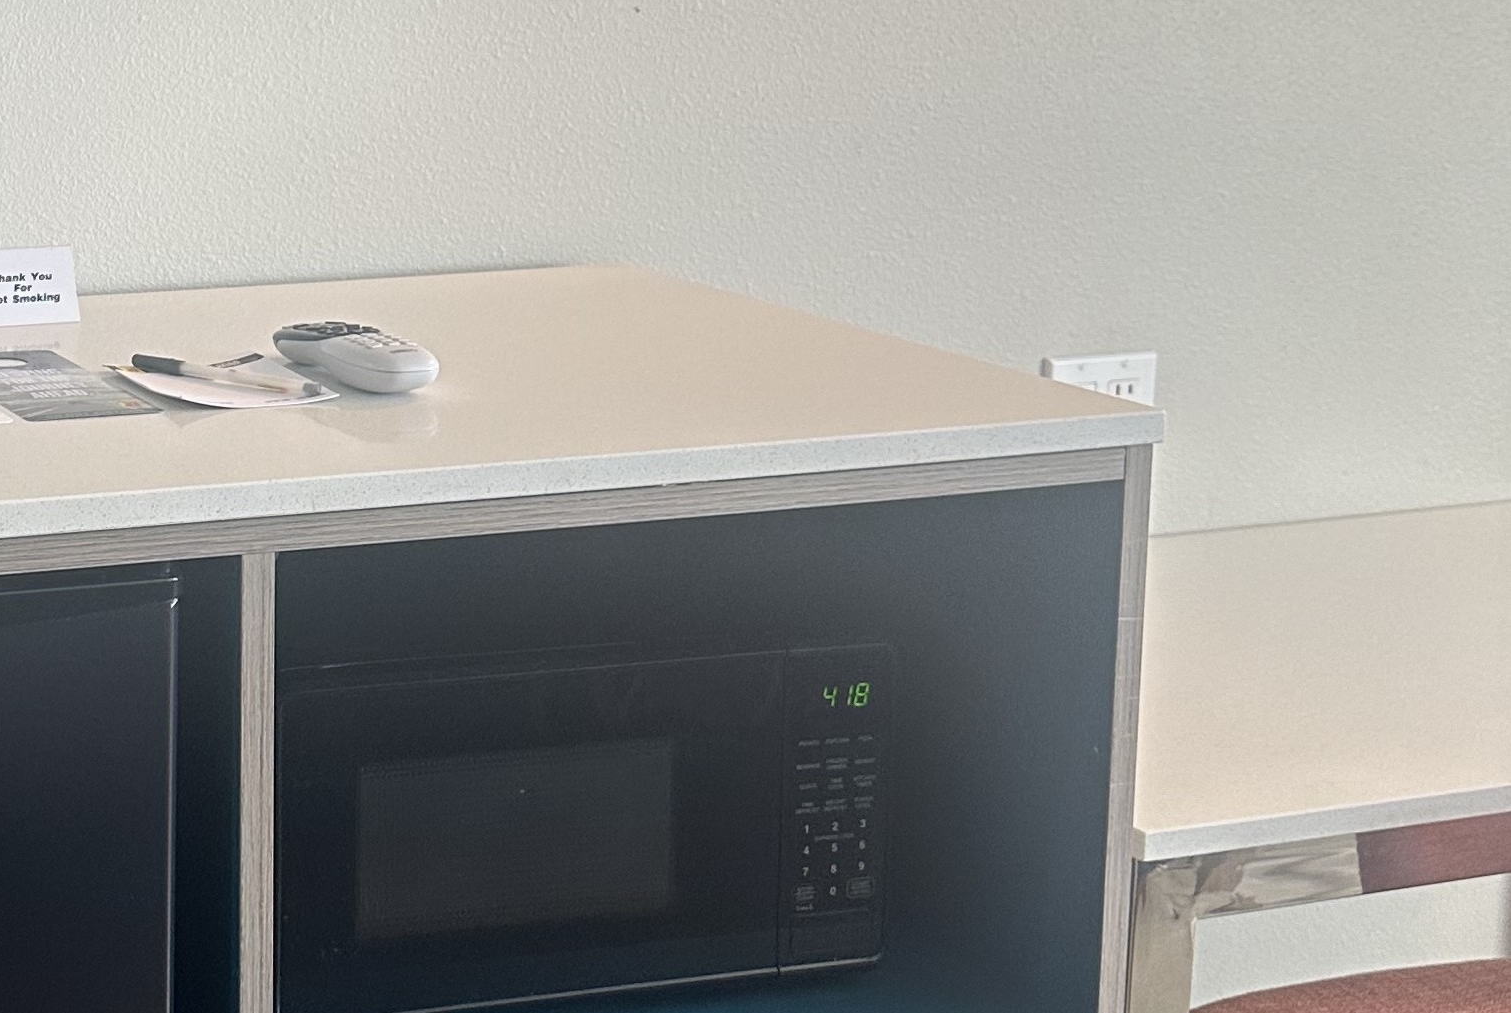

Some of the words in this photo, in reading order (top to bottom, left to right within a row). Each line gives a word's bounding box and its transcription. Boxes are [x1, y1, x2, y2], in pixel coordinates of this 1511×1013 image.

[31, 272, 52, 281] You
[14, 284, 32, 293] For
[12, 292, 61, 304] Smoking
[831, 821, 839, 831] 2
[859, 819, 867, 828] 3
[803, 824, 810, 834] 1
[831, 842, 838, 852] 5
[859, 839, 866, 850] 6
[803, 845, 810, 855] 4
[830, 863, 837, 874] 8
[858, 861, 865, 871] 9
[802, 866, 810, 877] 7
[829, 886, 837, 896] 0
